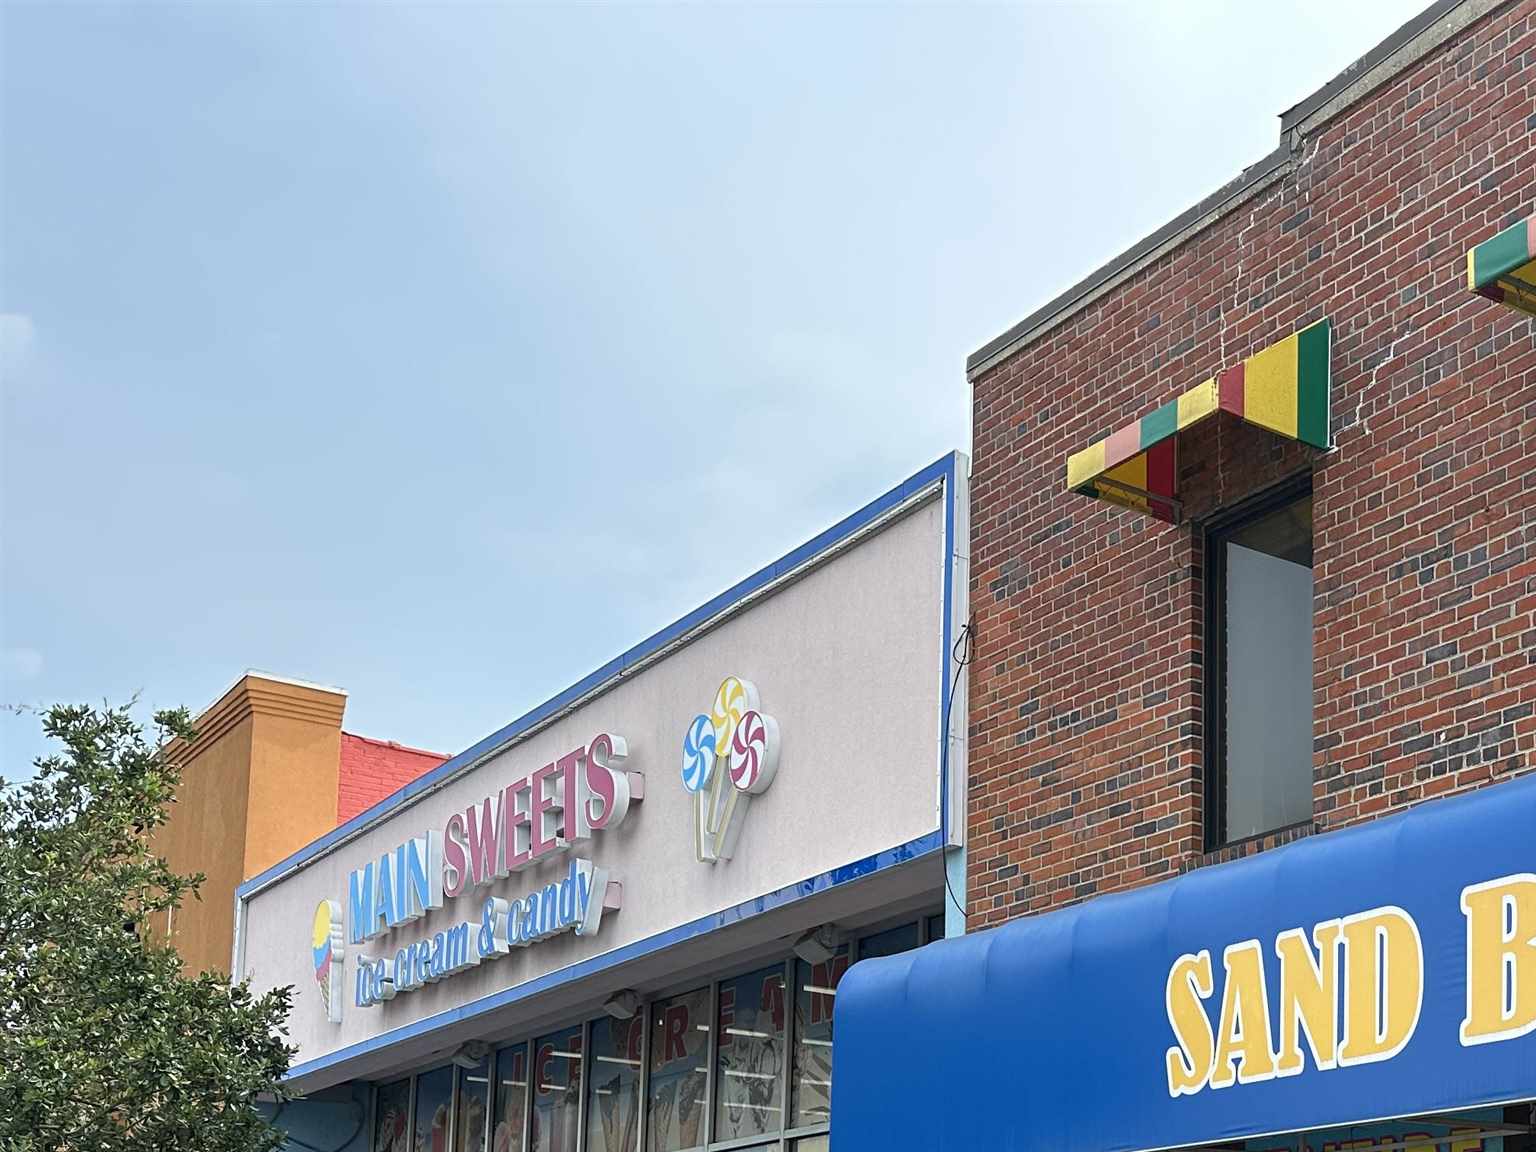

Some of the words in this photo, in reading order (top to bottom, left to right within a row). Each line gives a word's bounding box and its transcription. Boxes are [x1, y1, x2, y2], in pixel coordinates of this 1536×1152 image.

[349, 830, 440, 944] MAIN
[443, 733, 627, 897] SWEETS
[356, 953, 393, 1007] ice
[393, 921, 479, 992] cream
[477, 896, 508, 959] &
[505, 858, 604, 946] candy
[1164, 902, 1424, 1099] SAND
